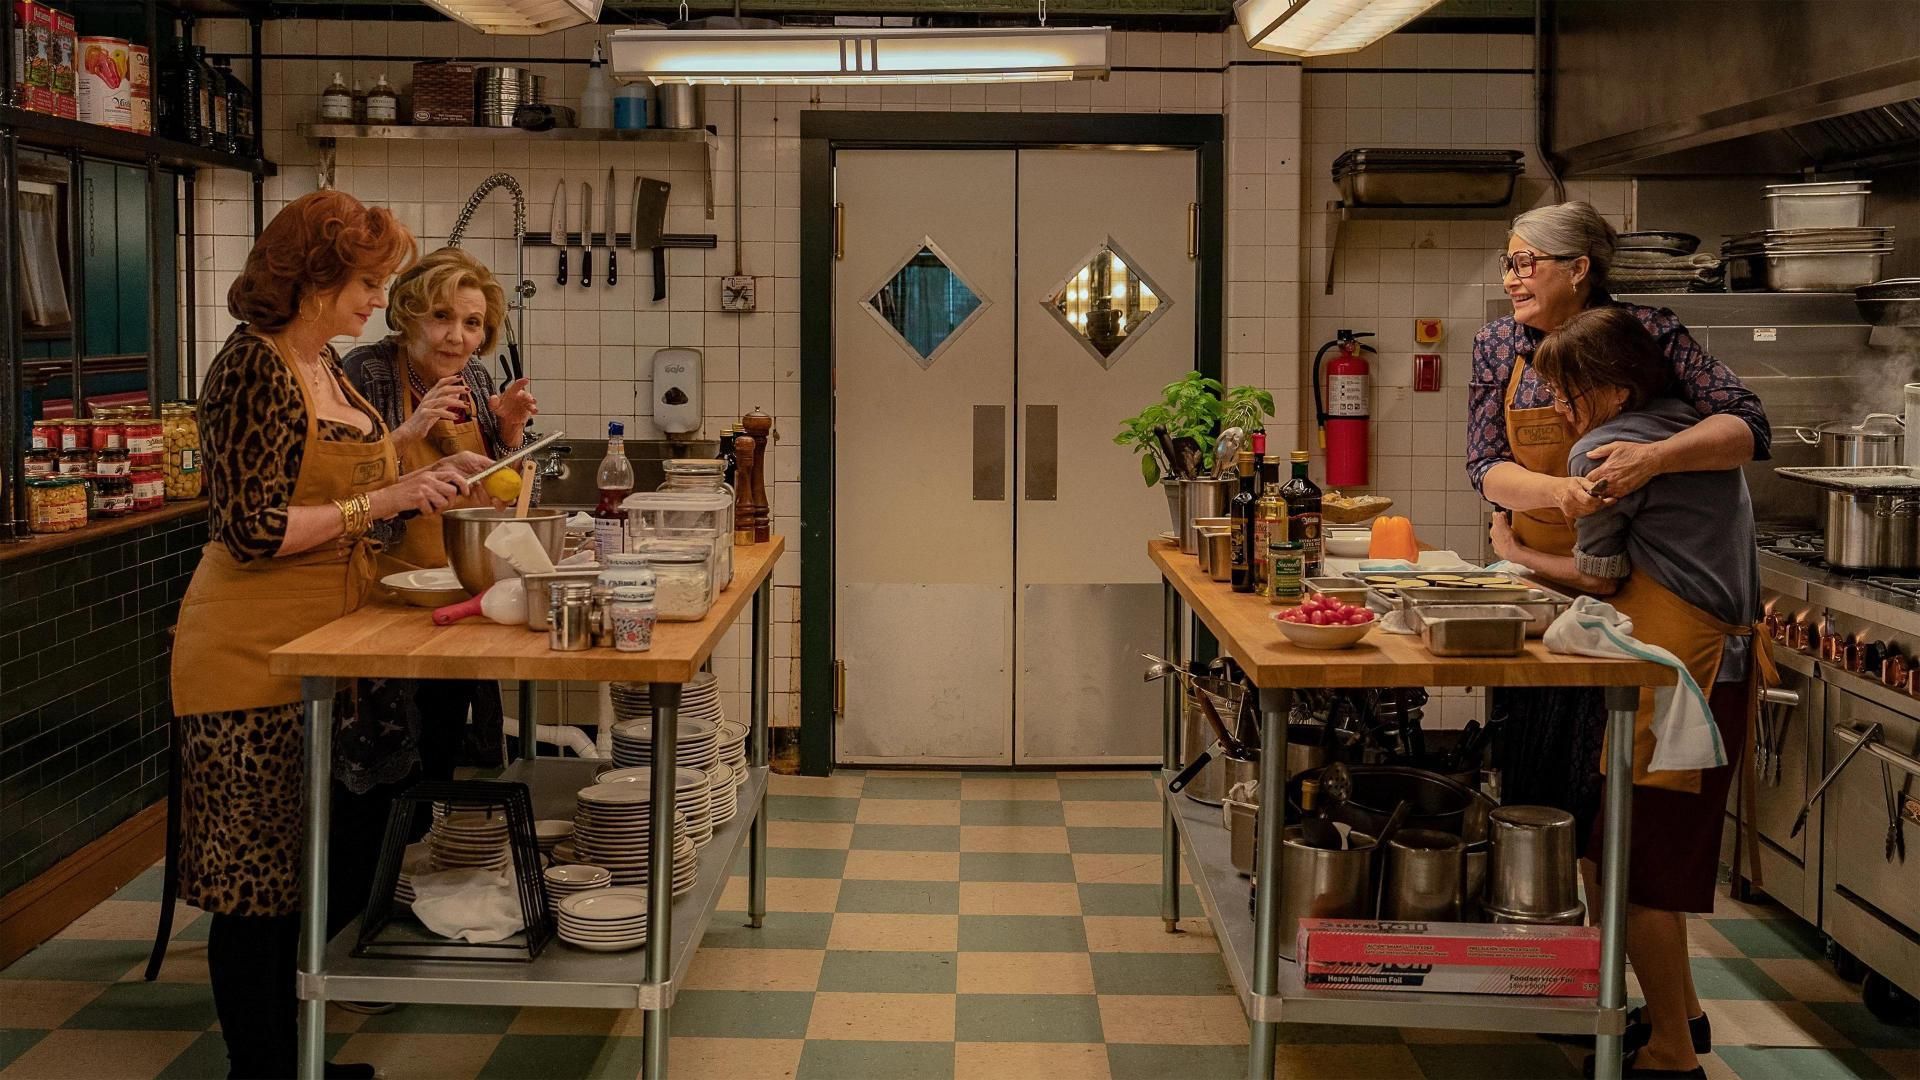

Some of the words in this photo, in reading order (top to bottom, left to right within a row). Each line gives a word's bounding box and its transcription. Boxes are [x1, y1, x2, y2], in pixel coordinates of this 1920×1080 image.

[1327, 975, 1350, 983] Heavy
[1351, 976, 1387, 984] Aluminum
[1509, 974, 1558, 983] Foodservice
